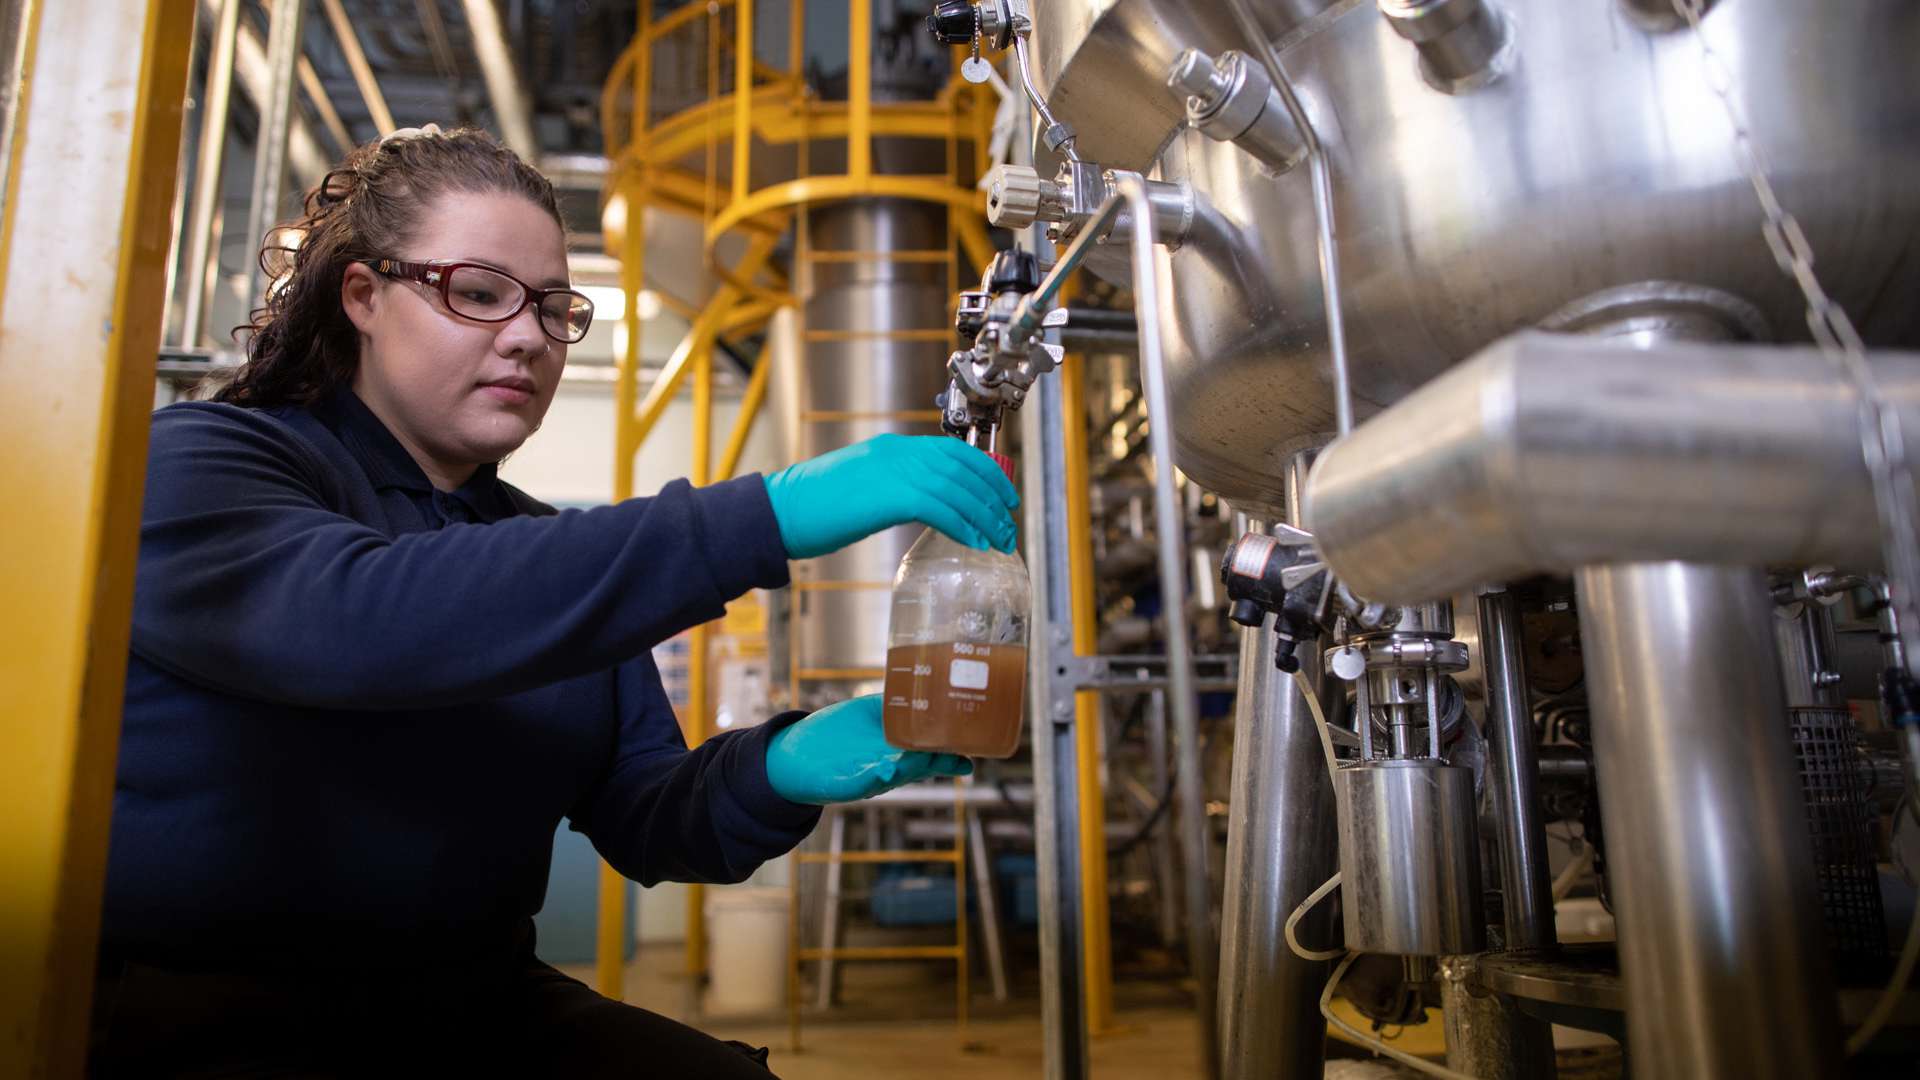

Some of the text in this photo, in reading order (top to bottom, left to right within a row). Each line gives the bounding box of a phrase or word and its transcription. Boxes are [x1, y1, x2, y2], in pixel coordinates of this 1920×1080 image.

[953, 643, 990, 656] 500 ml
[914, 664, 931, 675] 200
[911, 699, 928, 710] 100
